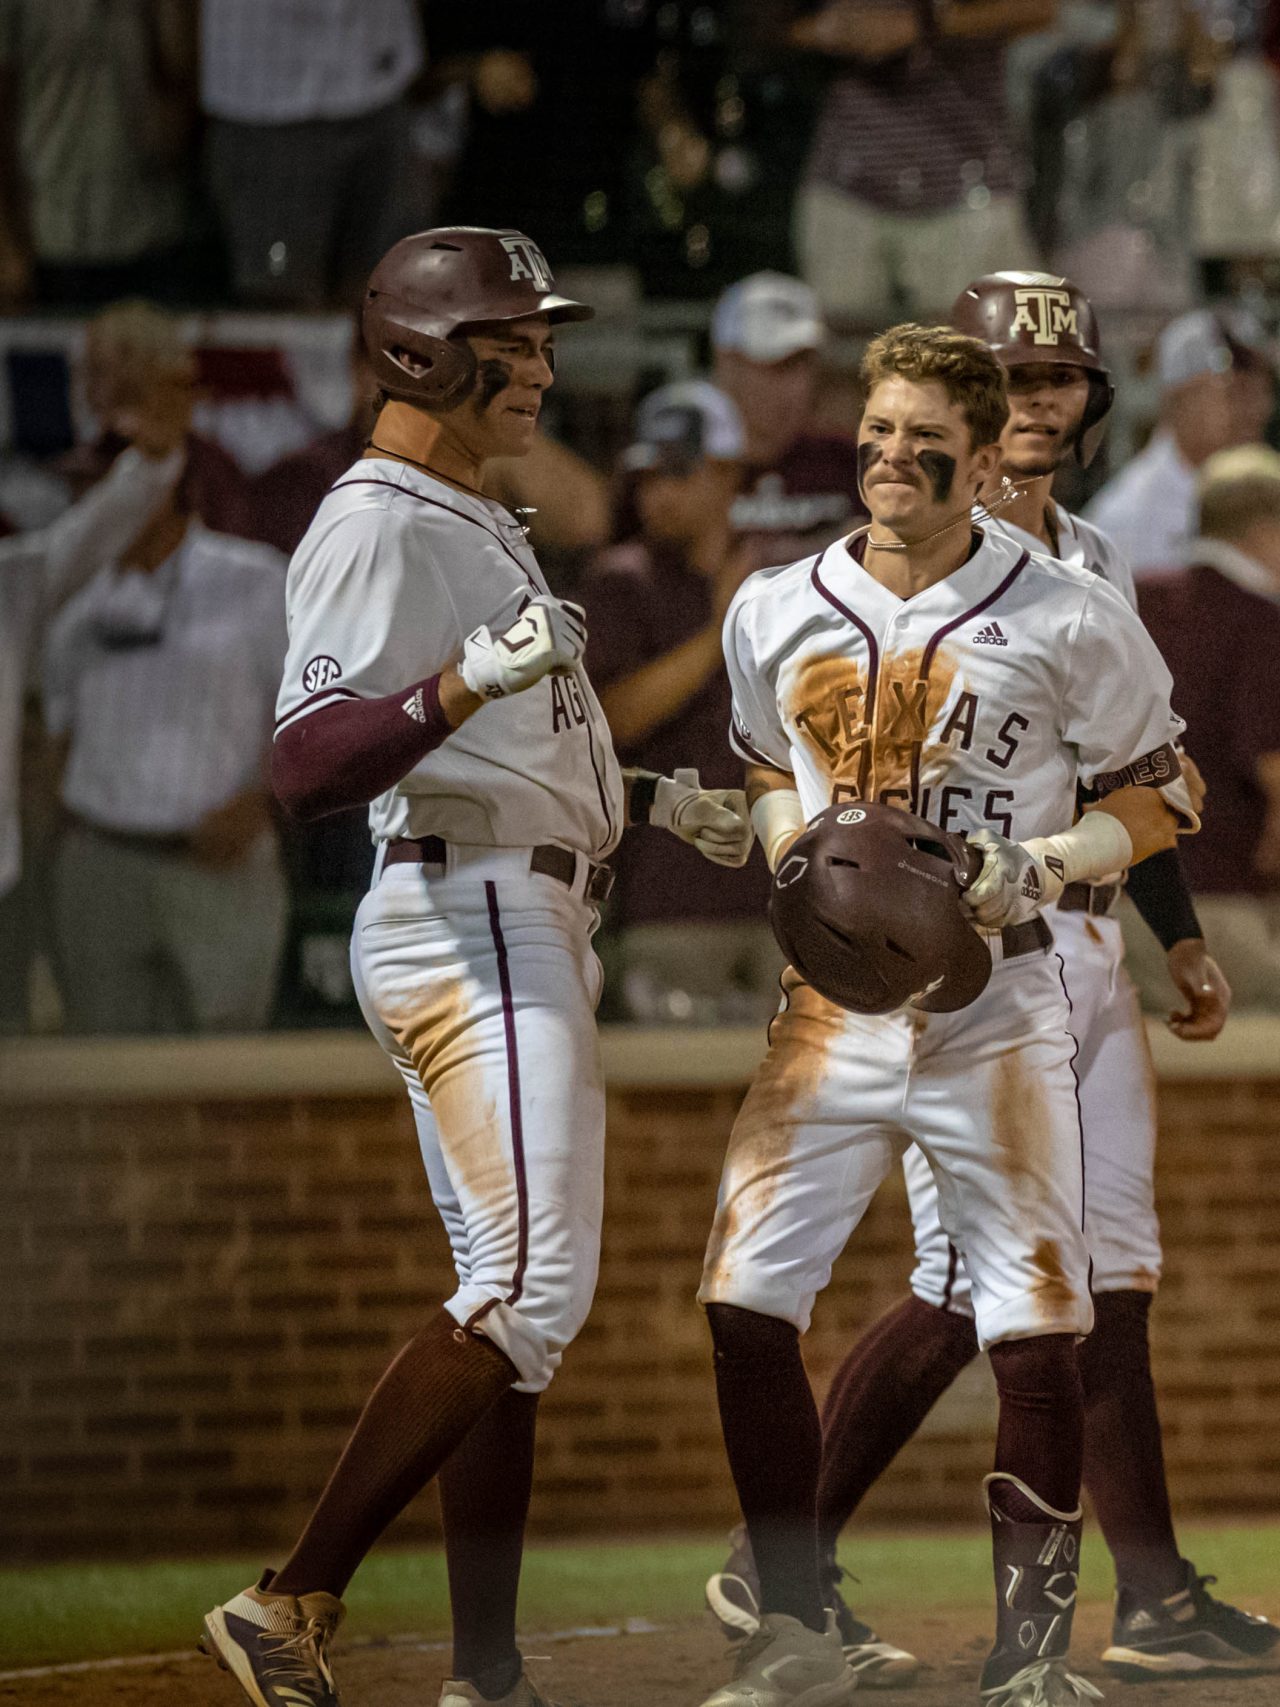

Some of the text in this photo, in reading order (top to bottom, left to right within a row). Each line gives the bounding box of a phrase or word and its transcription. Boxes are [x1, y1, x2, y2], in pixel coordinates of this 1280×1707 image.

[973, 636, 1008, 647] adidas
[303, 655, 342, 692] SEC
[795, 681, 1030, 770] TEXAS
